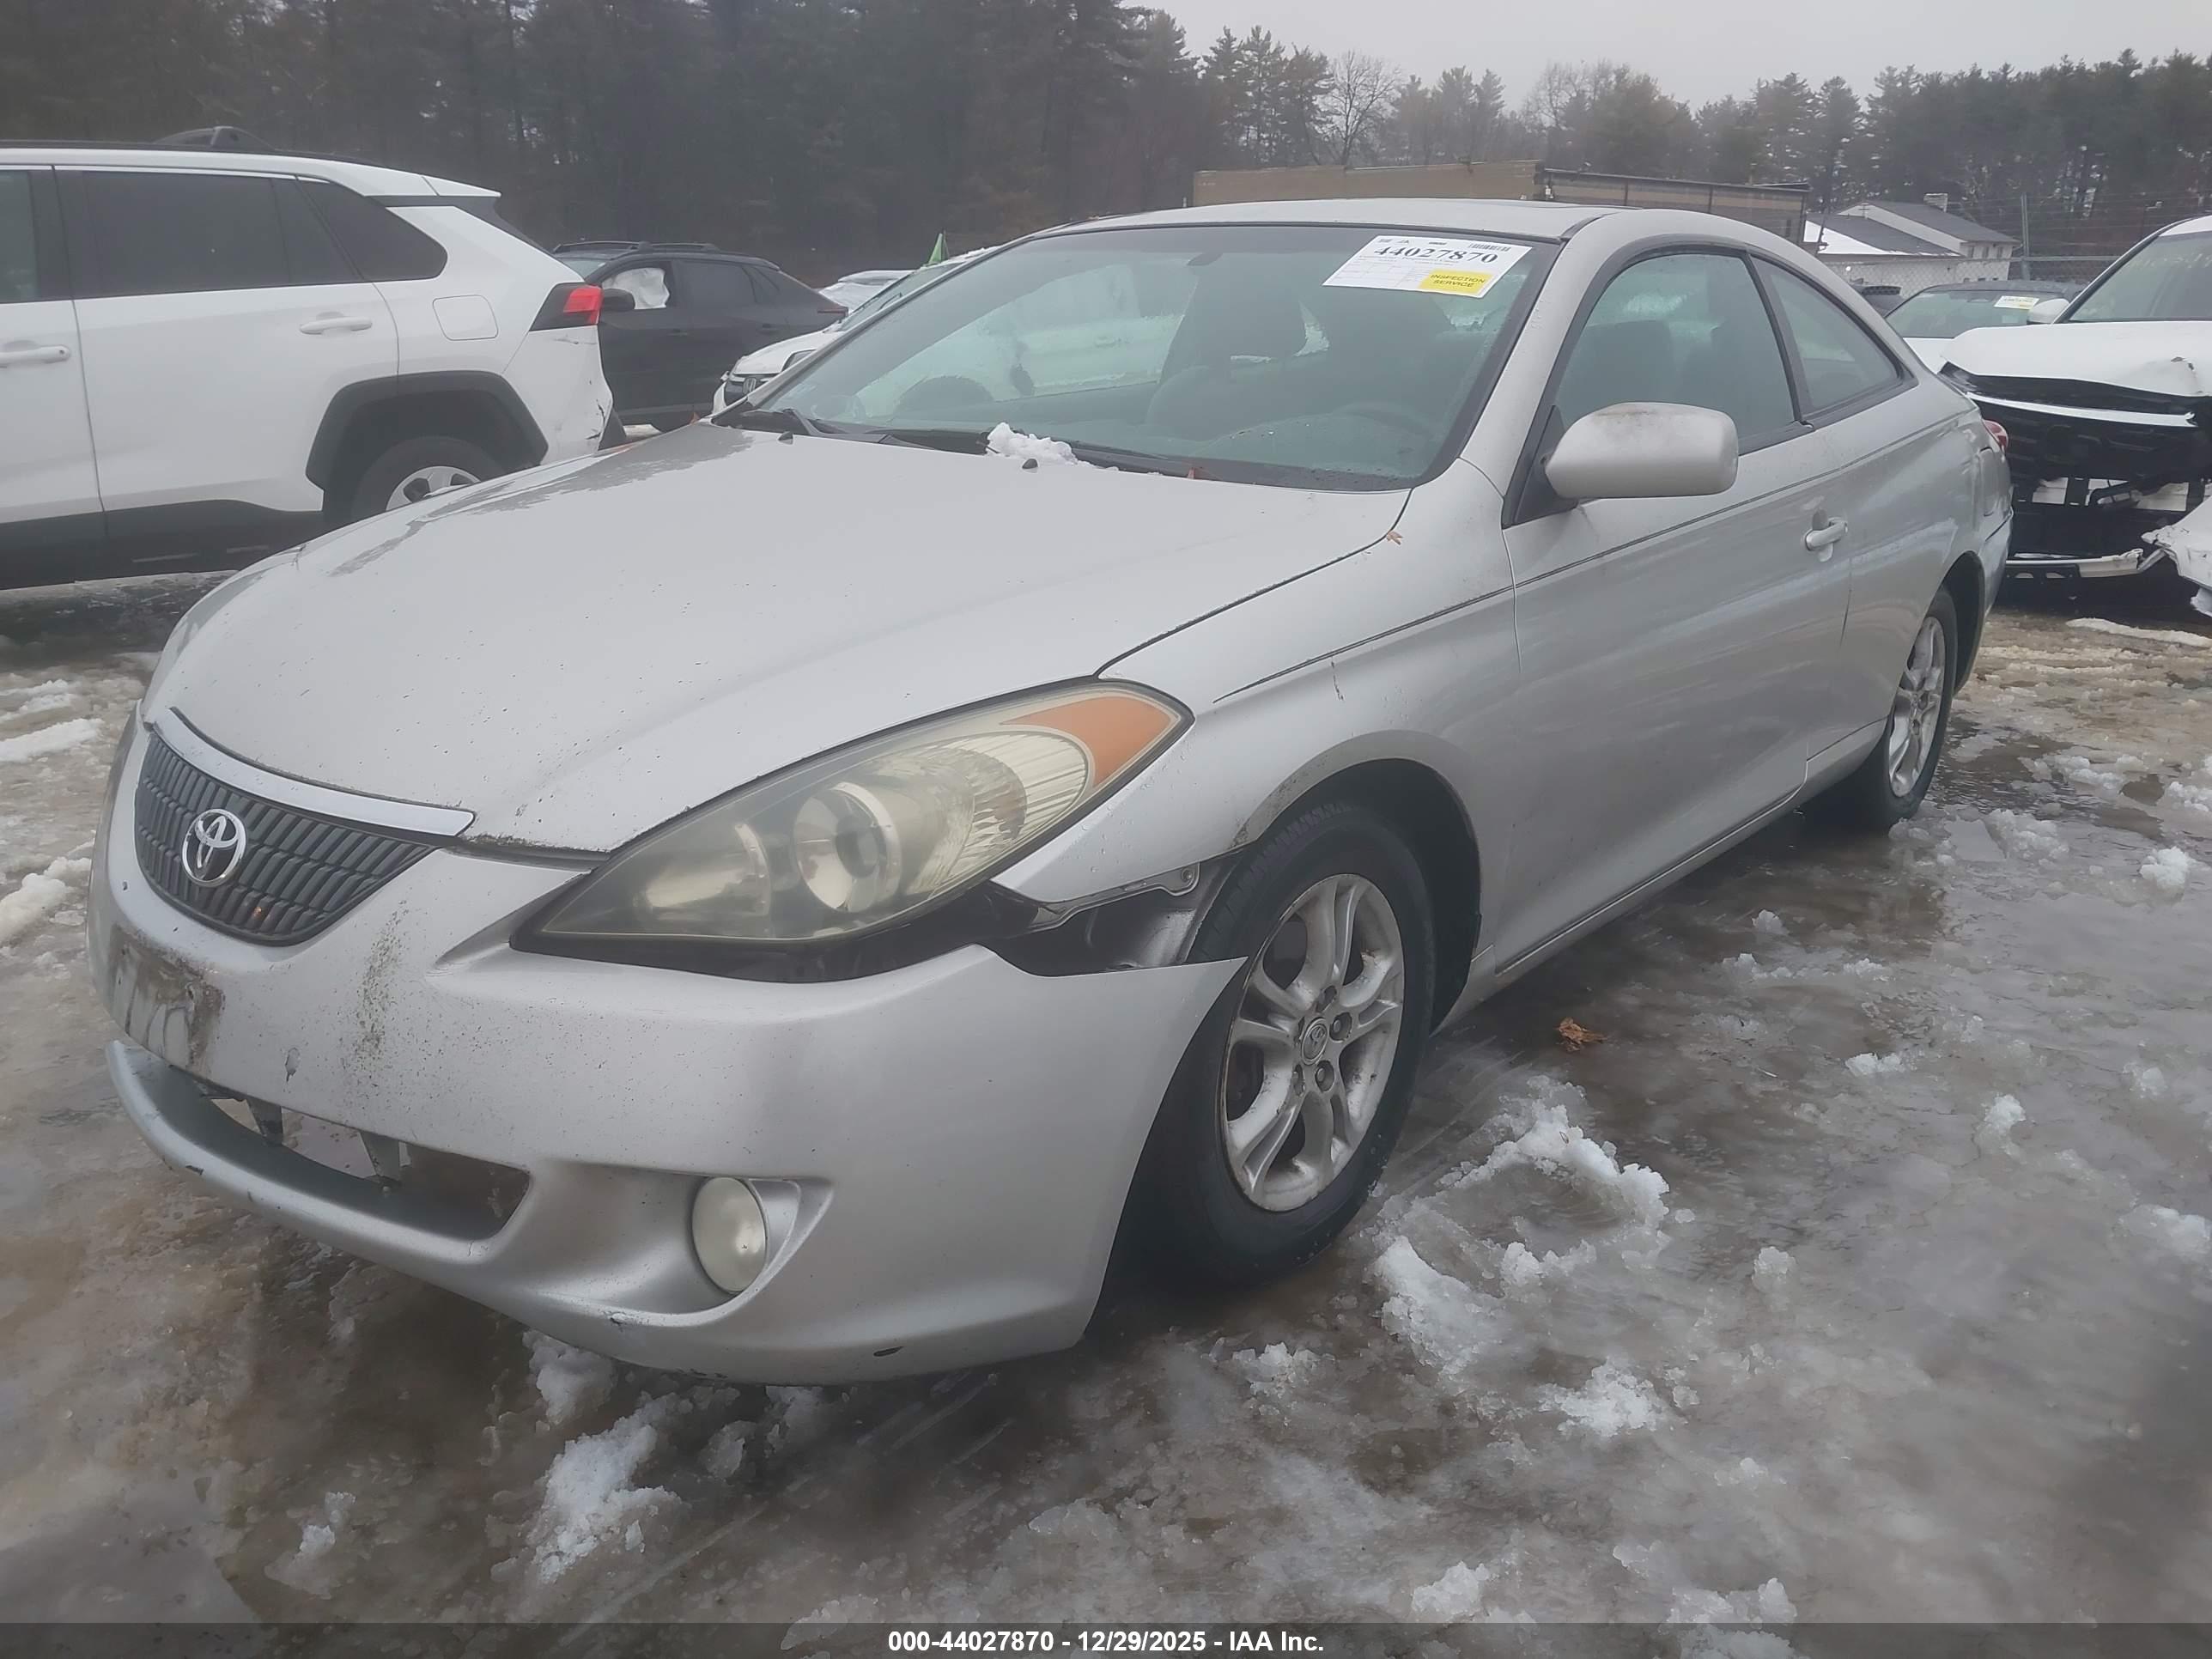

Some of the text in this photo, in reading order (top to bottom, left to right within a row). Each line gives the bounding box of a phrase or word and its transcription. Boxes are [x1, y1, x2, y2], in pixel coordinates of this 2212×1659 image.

[1374, 246, 1498, 264] 44027870
[1431, 274, 1486, 283] INSPECTION
[1433, 279, 1475, 288] SERVICE
